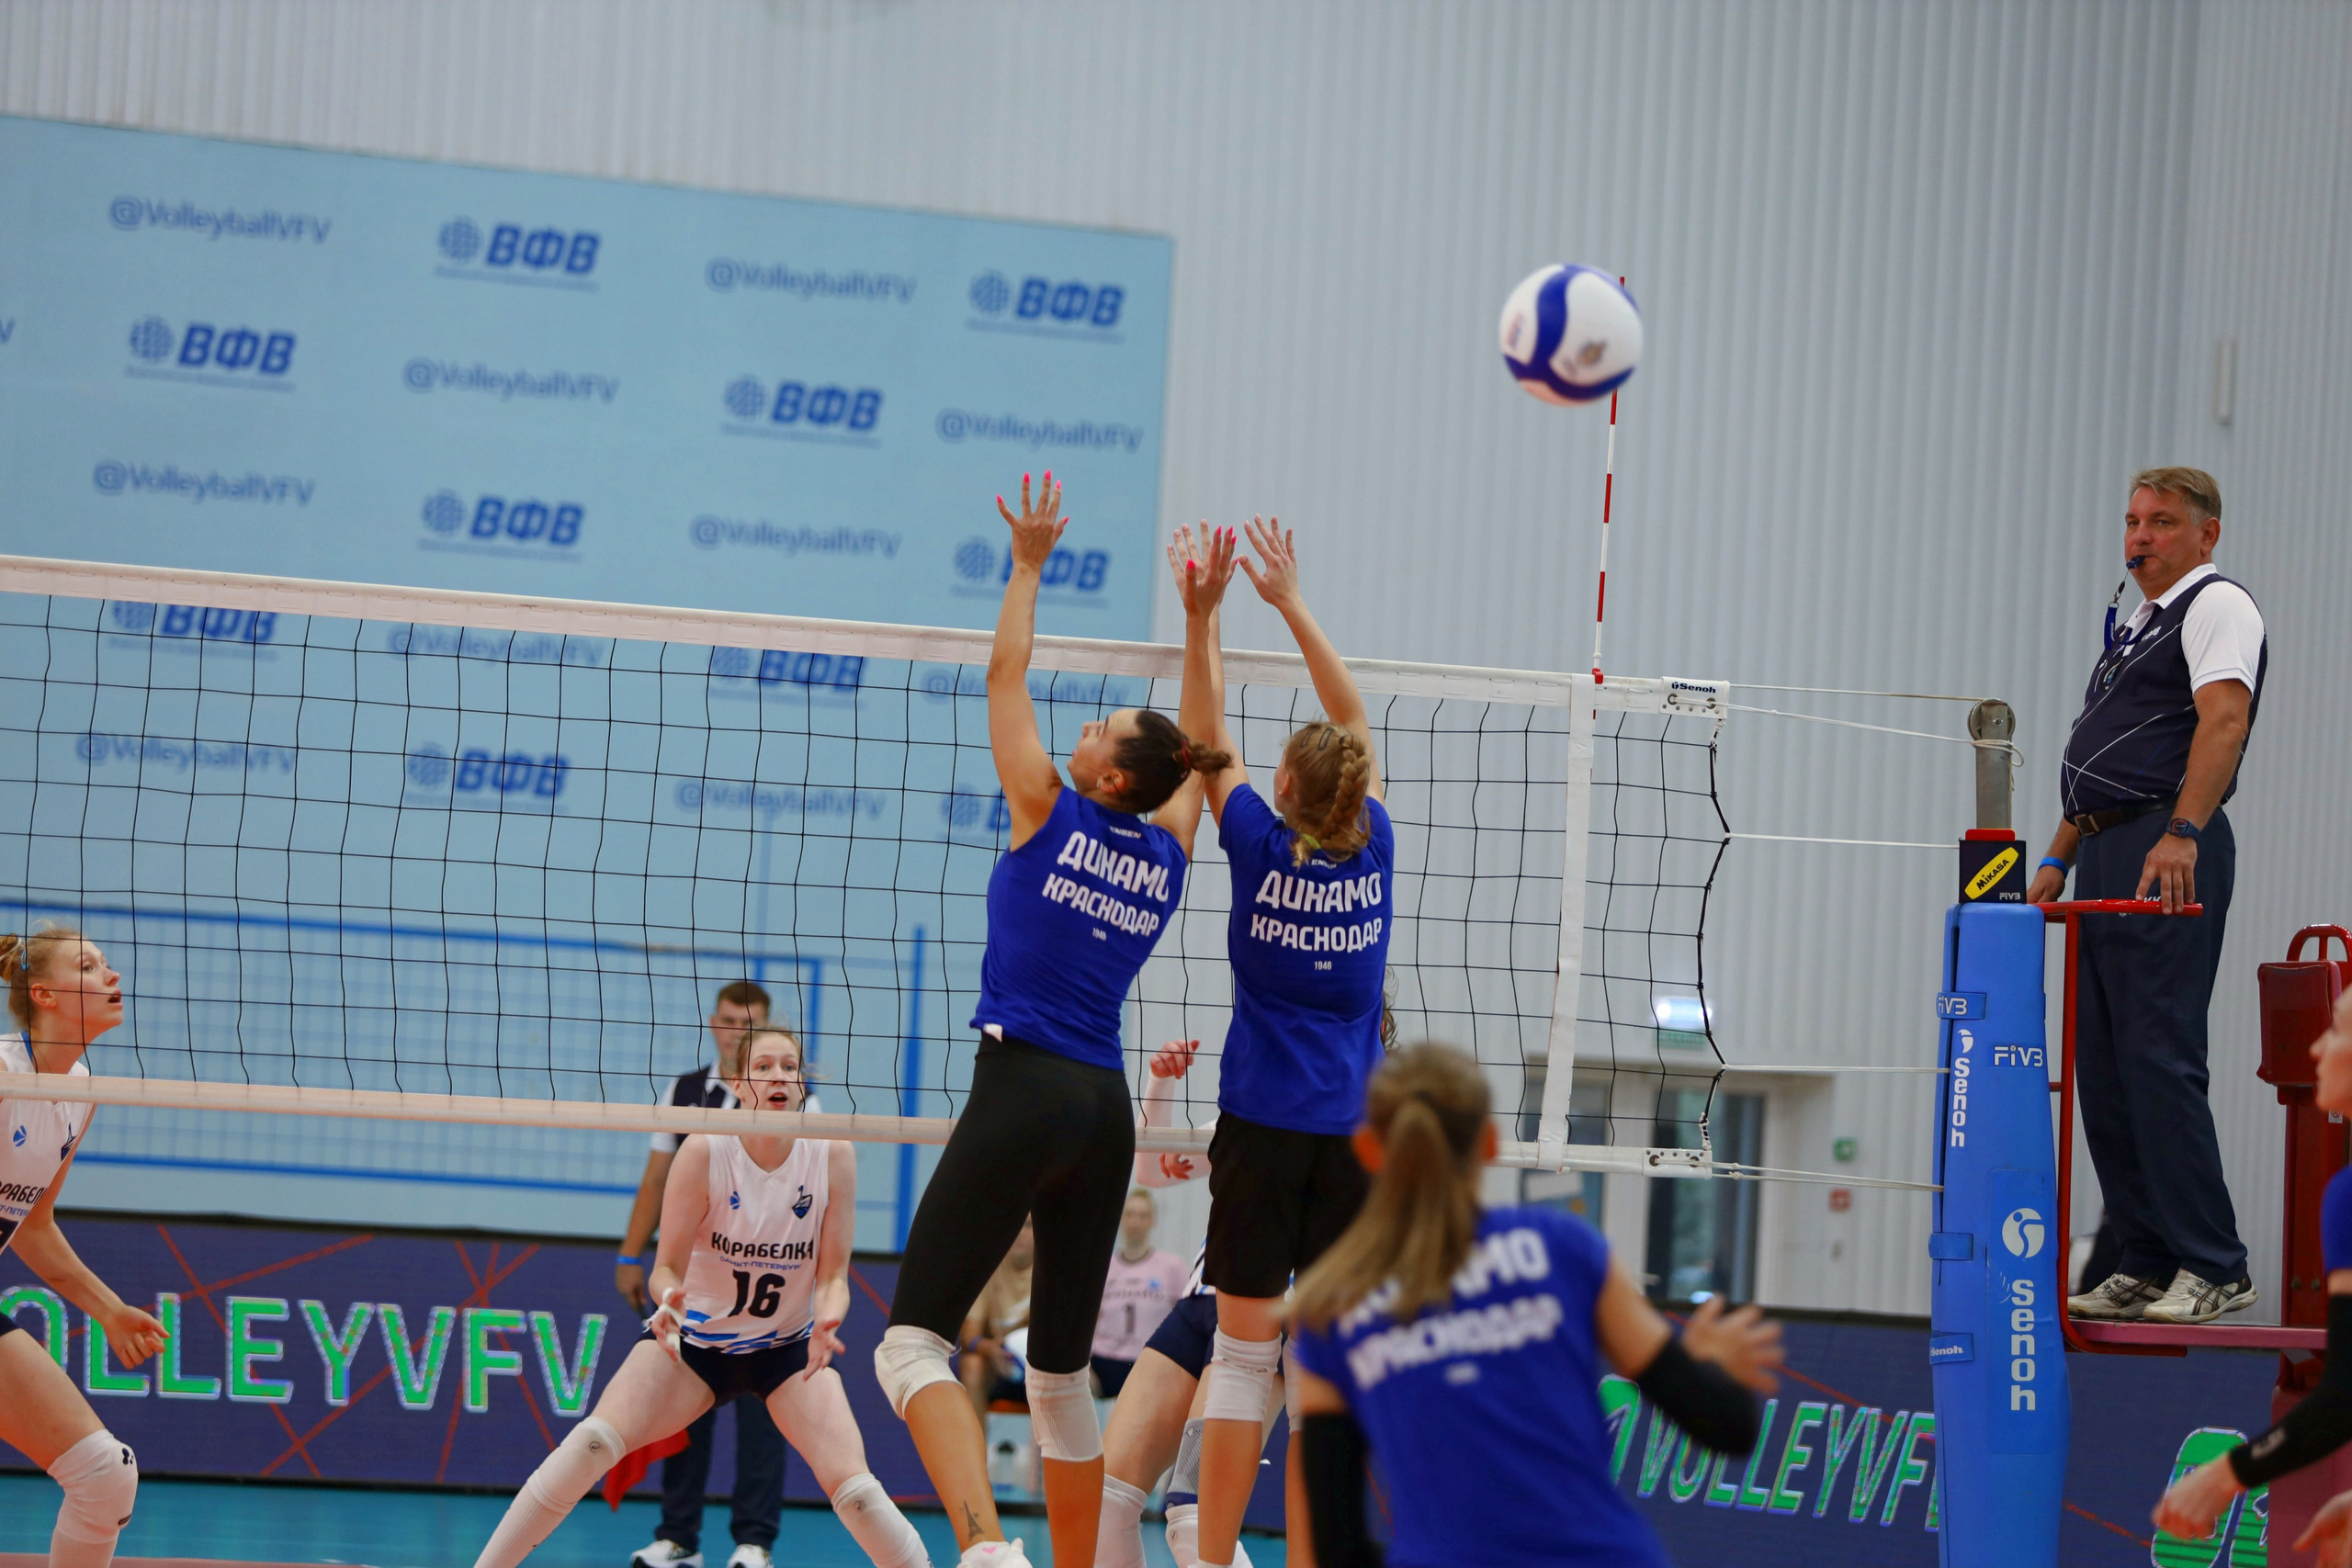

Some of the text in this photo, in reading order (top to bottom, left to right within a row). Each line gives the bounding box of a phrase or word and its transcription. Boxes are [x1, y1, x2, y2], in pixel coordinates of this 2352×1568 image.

[108, 195, 332, 244] @VolleyballVFV
[485, 221, 601, 276] ВФВ
[705, 255, 918, 304] @VolleyballVFV
[1014, 276, 1126, 329] ВФВ
[177, 321, 298, 377] ВФВ
[402, 356, 620, 404] @VolleyballVFV
[771, 378, 885, 433] ВФВ
[934, 407, 1144, 455] @VolleyballVFV
[93, 460, 316, 508] @VolleyballVFV
[469, 494, 585, 548] ВФВ
[689, 512, 902, 559] @VolleyballVFV
[757, 649, 869, 694] ВФВ
[1679, 682, 1716, 694] Senoh
[456, 746, 571, 798] ВФВ
[1042, 873, 1160, 937] КРАСНОДАР
[1255, 870, 1382, 913] ДИНАМО
[1250, 913, 1383, 953] КРАСНОДАР
[1951, 1057, 1971, 1147] Senoh
[711, 1232, 814, 1260] КОРАБЕЛКА
[728, 1269, 786, 1318] 16
[2010, 1280, 2036, 1411] Senoh
